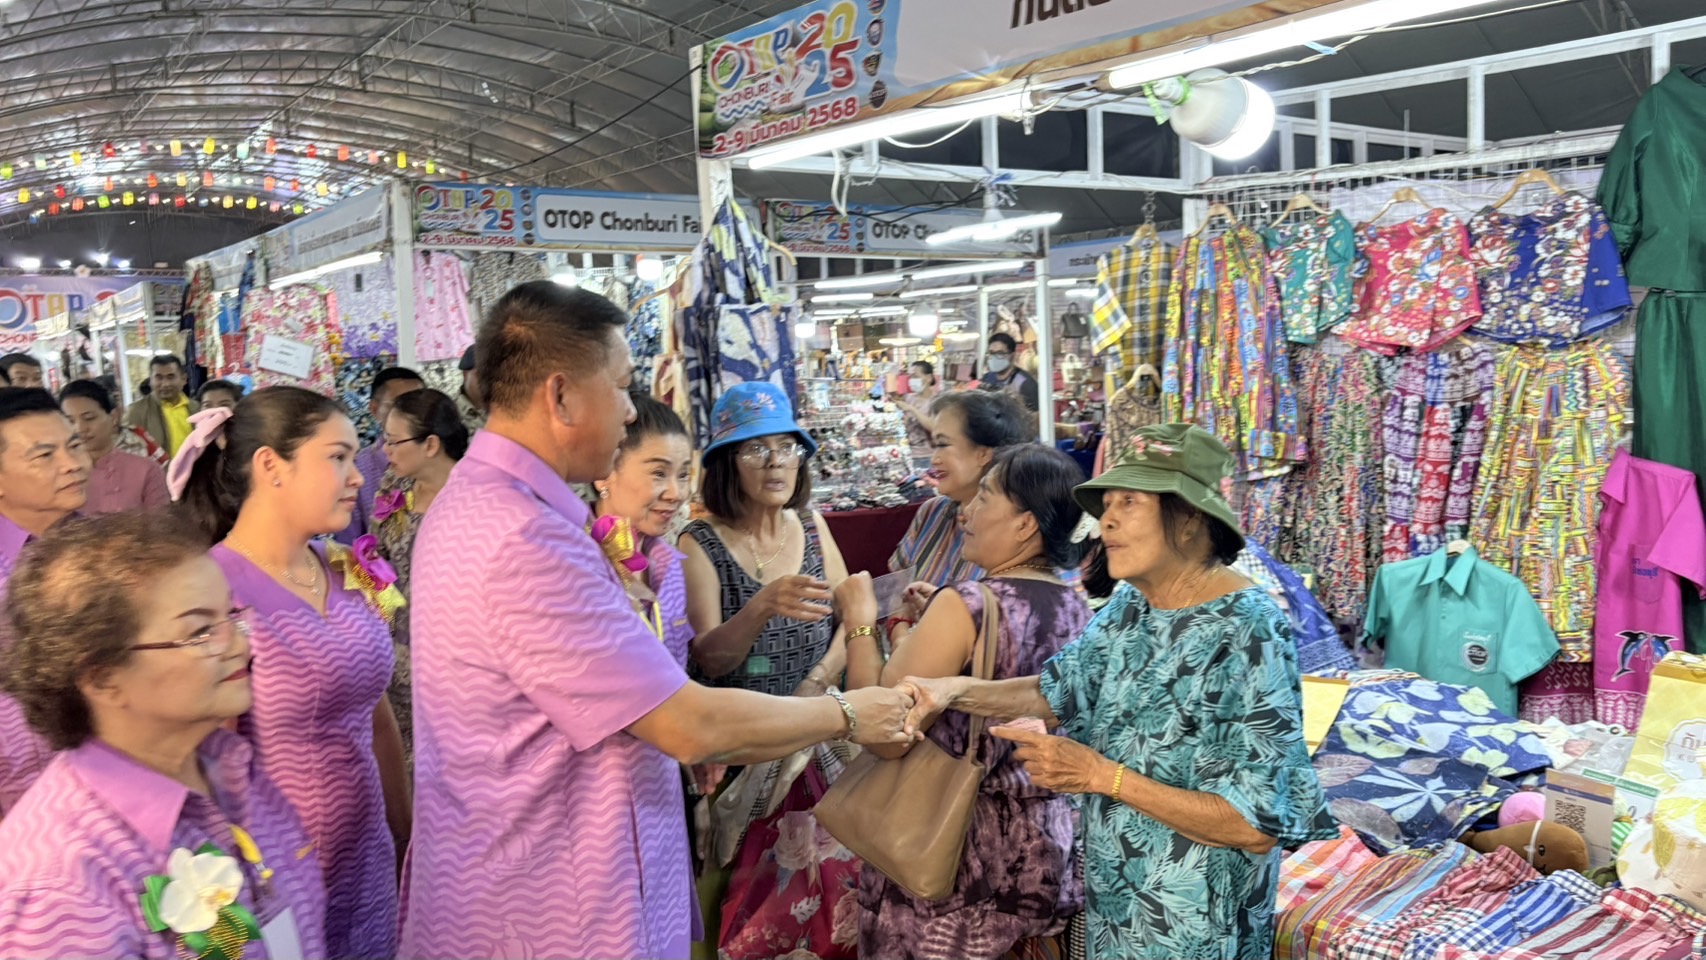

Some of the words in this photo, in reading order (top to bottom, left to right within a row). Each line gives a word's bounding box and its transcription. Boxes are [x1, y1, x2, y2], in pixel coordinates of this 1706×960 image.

[795, 2, 856, 61] 20
[804, 39, 860, 97] 25
[770, 92, 794, 106] Fair
[714, 130, 745, 152] 2-9
[751, 116, 800, 144] มีนาคม
[807, 97, 857, 127] 2568
[480, 189, 512, 211] 20
[484, 209, 514, 231] 25
[545, 209, 594, 230] OTOP
[600, 211, 678, 233] Chonburi
[682, 214, 702, 234] Fai
[872, 222, 910, 240] OTOP
[827, 223, 850, 241] 25
